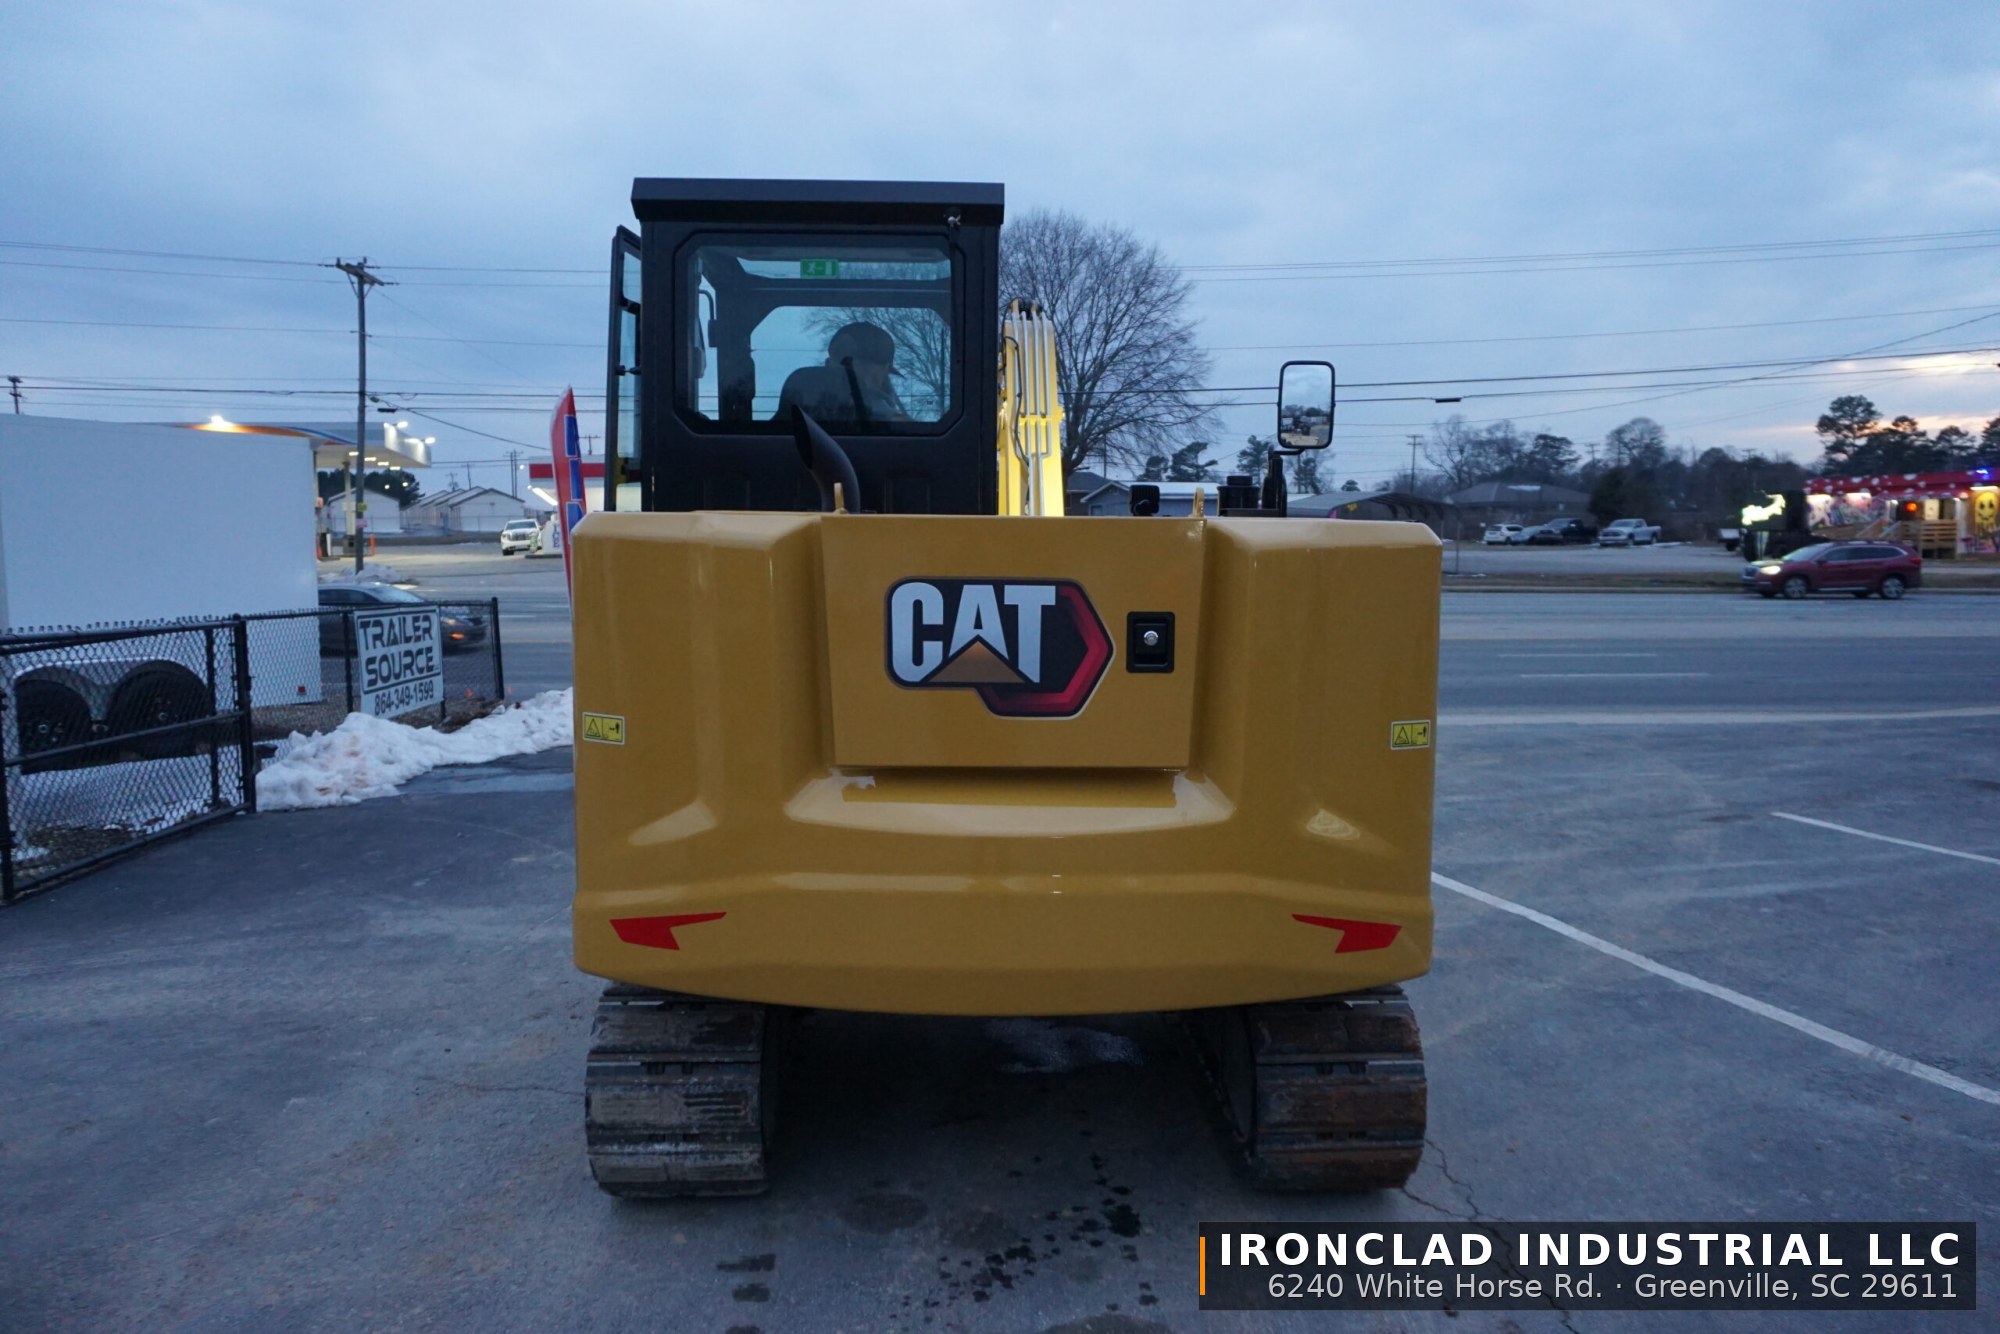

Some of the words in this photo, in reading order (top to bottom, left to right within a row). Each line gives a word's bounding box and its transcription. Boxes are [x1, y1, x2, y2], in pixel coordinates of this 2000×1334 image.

[360, 615, 433, 651] TRAILER
[891, 582, 1056, 684] CAT
[365, 646, 434, 688] SOURCE
[374, 680, 434, 716] 864-349-1599
